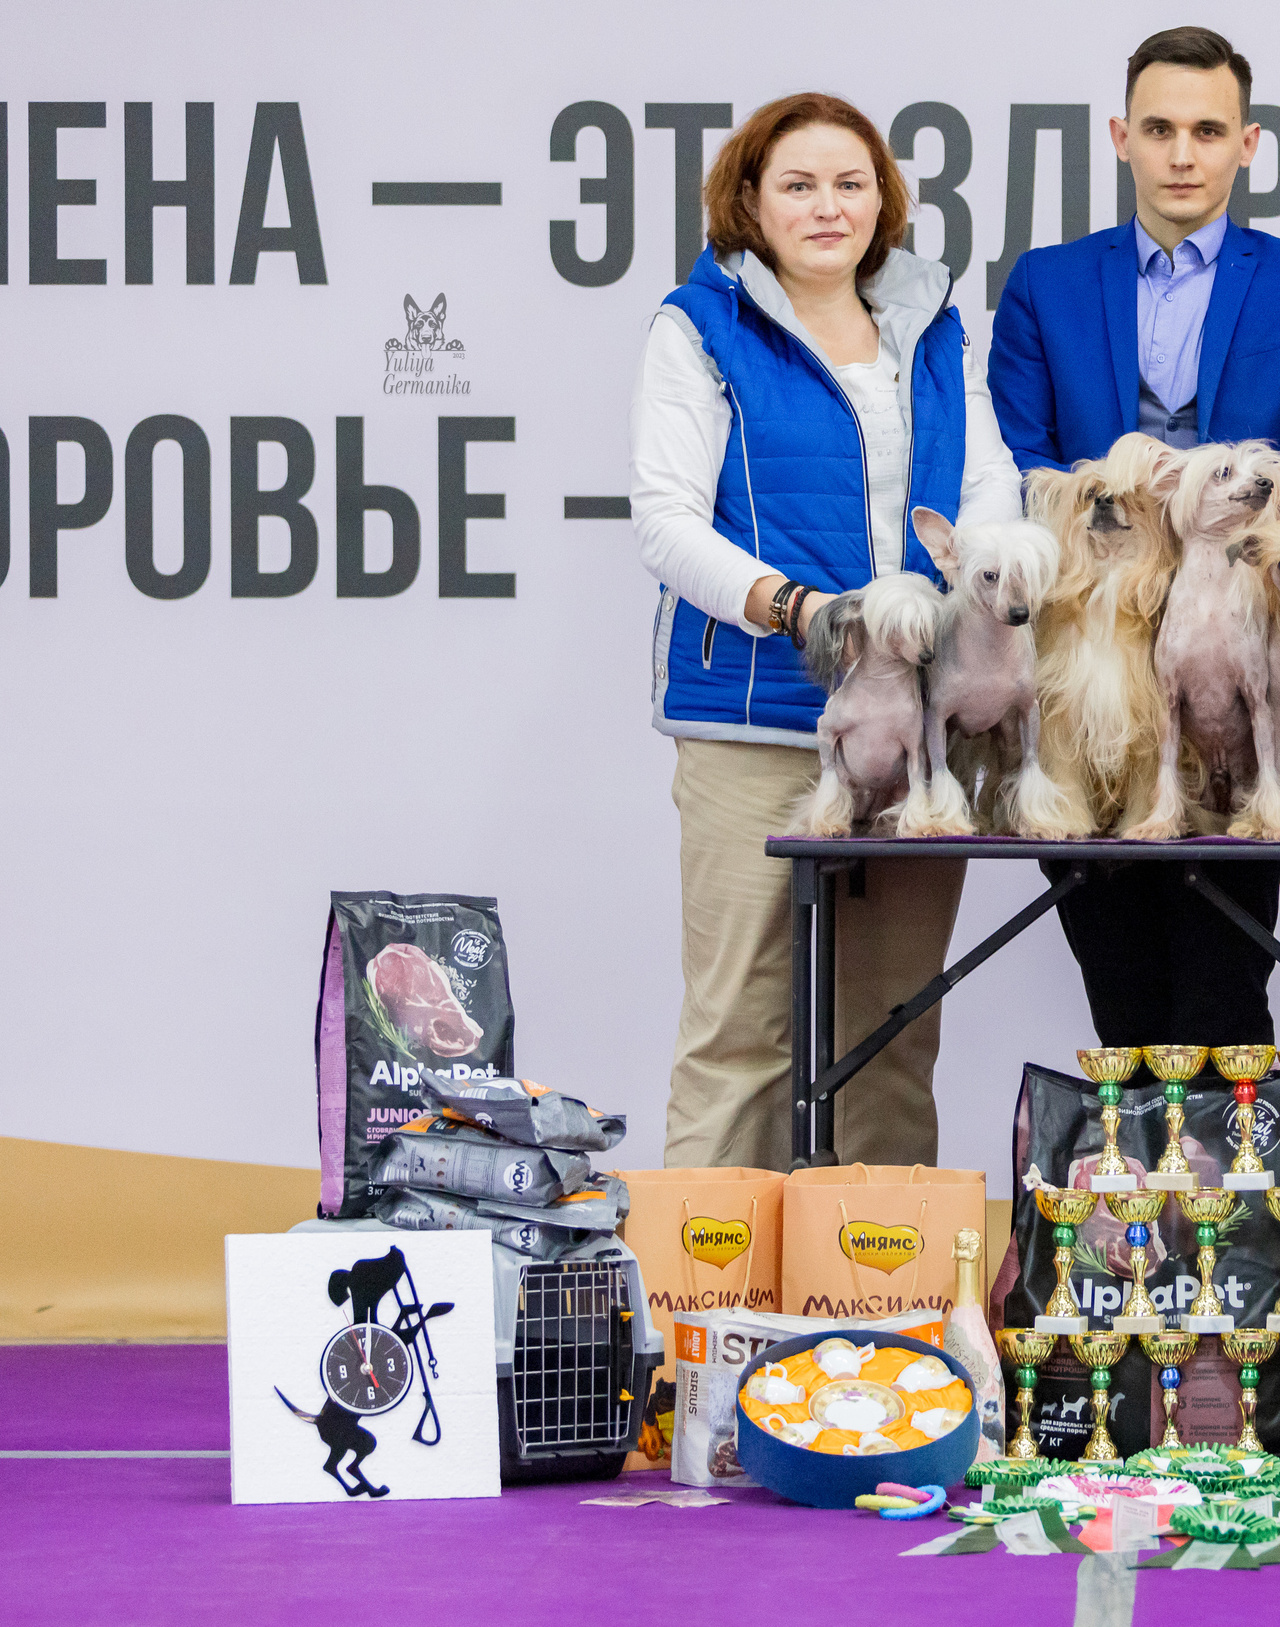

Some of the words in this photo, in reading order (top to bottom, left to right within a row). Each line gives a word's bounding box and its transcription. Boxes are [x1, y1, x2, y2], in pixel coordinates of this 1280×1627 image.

[0, 101, 329, 286] ЕНА
[0, 414, 516, 600] РОВЬЕ
[512, 1159, 526, 1196] WOW
[691, 1330, 701, 1358] ADULT
[711, 1330, 719, 1364] PREMIUM
[722, 1332, 781, 1366] SI
[339, 1364, 348, 1379] 9
[386, 1357, 396, 1372] 3
[366, 1386, 376, 1400] 6
[688, 1370, 699, 1417] SIRIUS
[1038, 1433, 1047, 1445] 7
